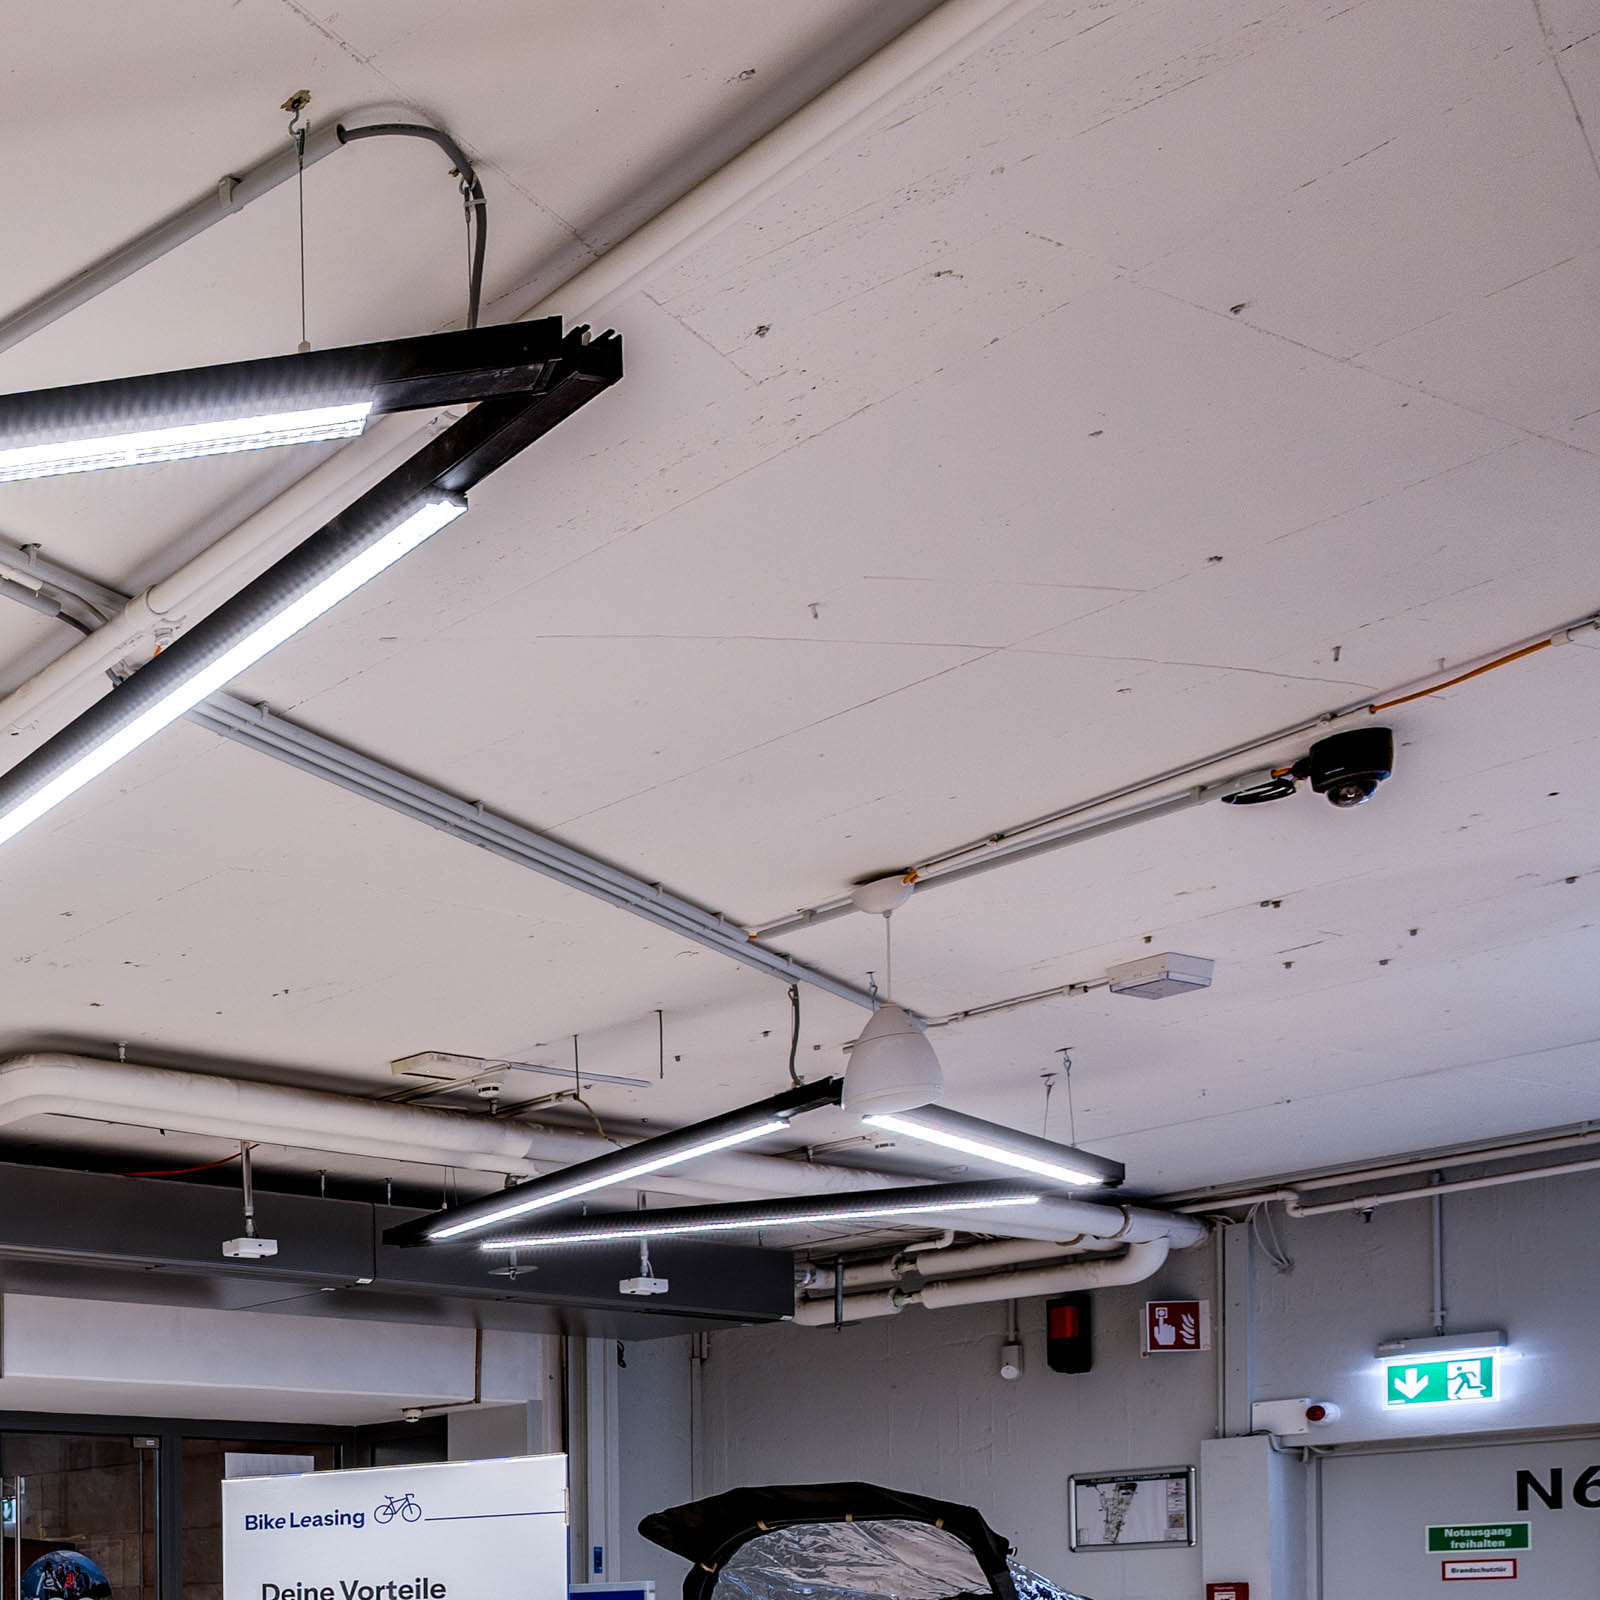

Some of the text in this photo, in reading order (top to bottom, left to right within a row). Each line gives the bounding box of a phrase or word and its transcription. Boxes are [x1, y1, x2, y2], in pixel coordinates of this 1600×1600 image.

[1516, 1465, 1600, 1512] N6
[245, 1510, 366, 1531] Bike Leasing
[1444, 1528, 1512, 1538] Notausgang
[1450, 1539, 1506, 1549] freihalten
